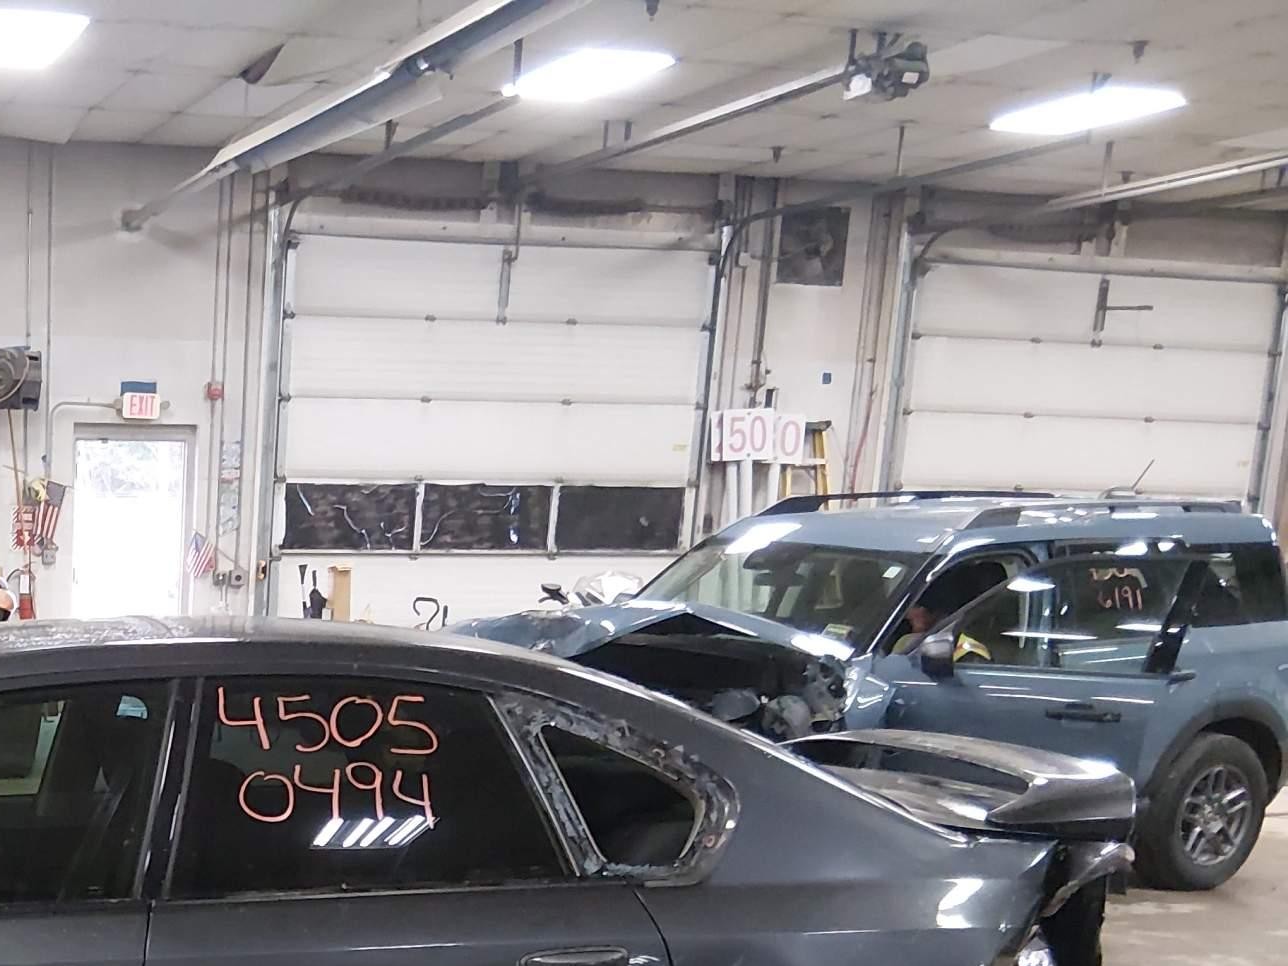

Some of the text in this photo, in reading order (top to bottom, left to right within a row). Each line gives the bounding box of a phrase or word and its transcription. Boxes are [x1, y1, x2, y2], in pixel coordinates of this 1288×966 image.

[129, 394, 156, 417] EXIT
[728, 415, 767, 453] 50
[773, 419, 801, 457] 0
[1096, 585, 1144, 610] 6191
[217, 686, 439, 755] 4505
[238, 761, 435, 829] 0494
